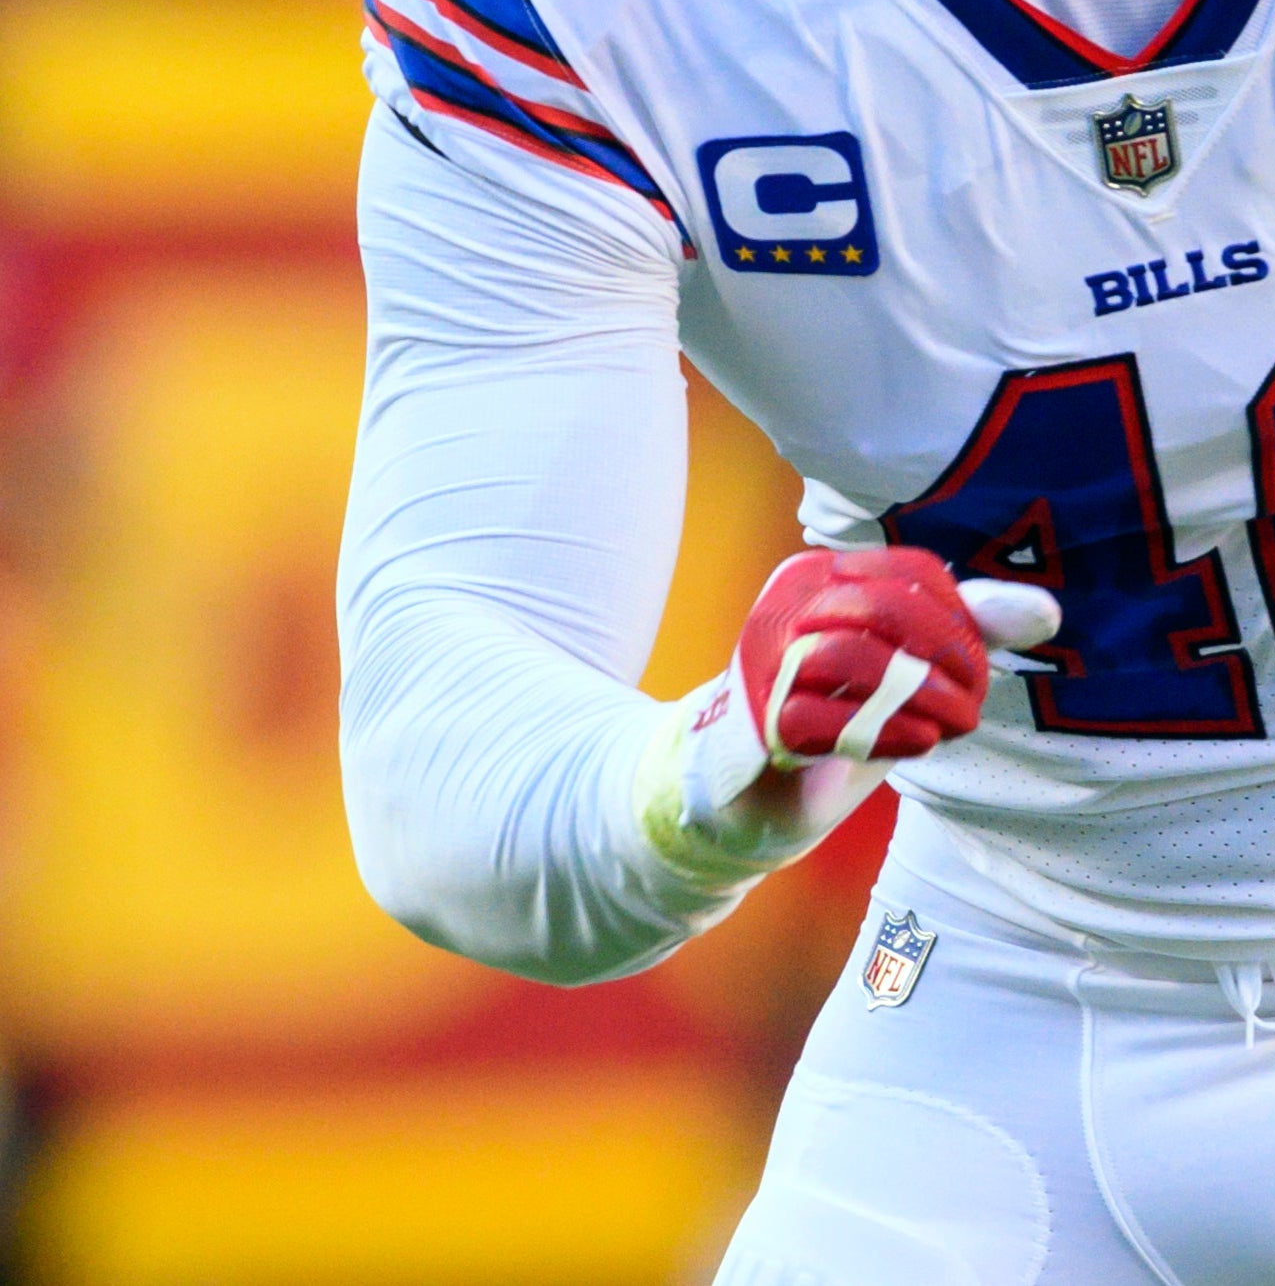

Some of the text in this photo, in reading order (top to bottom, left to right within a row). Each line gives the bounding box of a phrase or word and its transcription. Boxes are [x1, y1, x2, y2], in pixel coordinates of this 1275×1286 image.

[1110, 137, 1168, 179] NFL
[714, 145, 858, 240] C
[1084, 240, 1270, 316] BILLS
[866, 950, 906, 994] NFL
